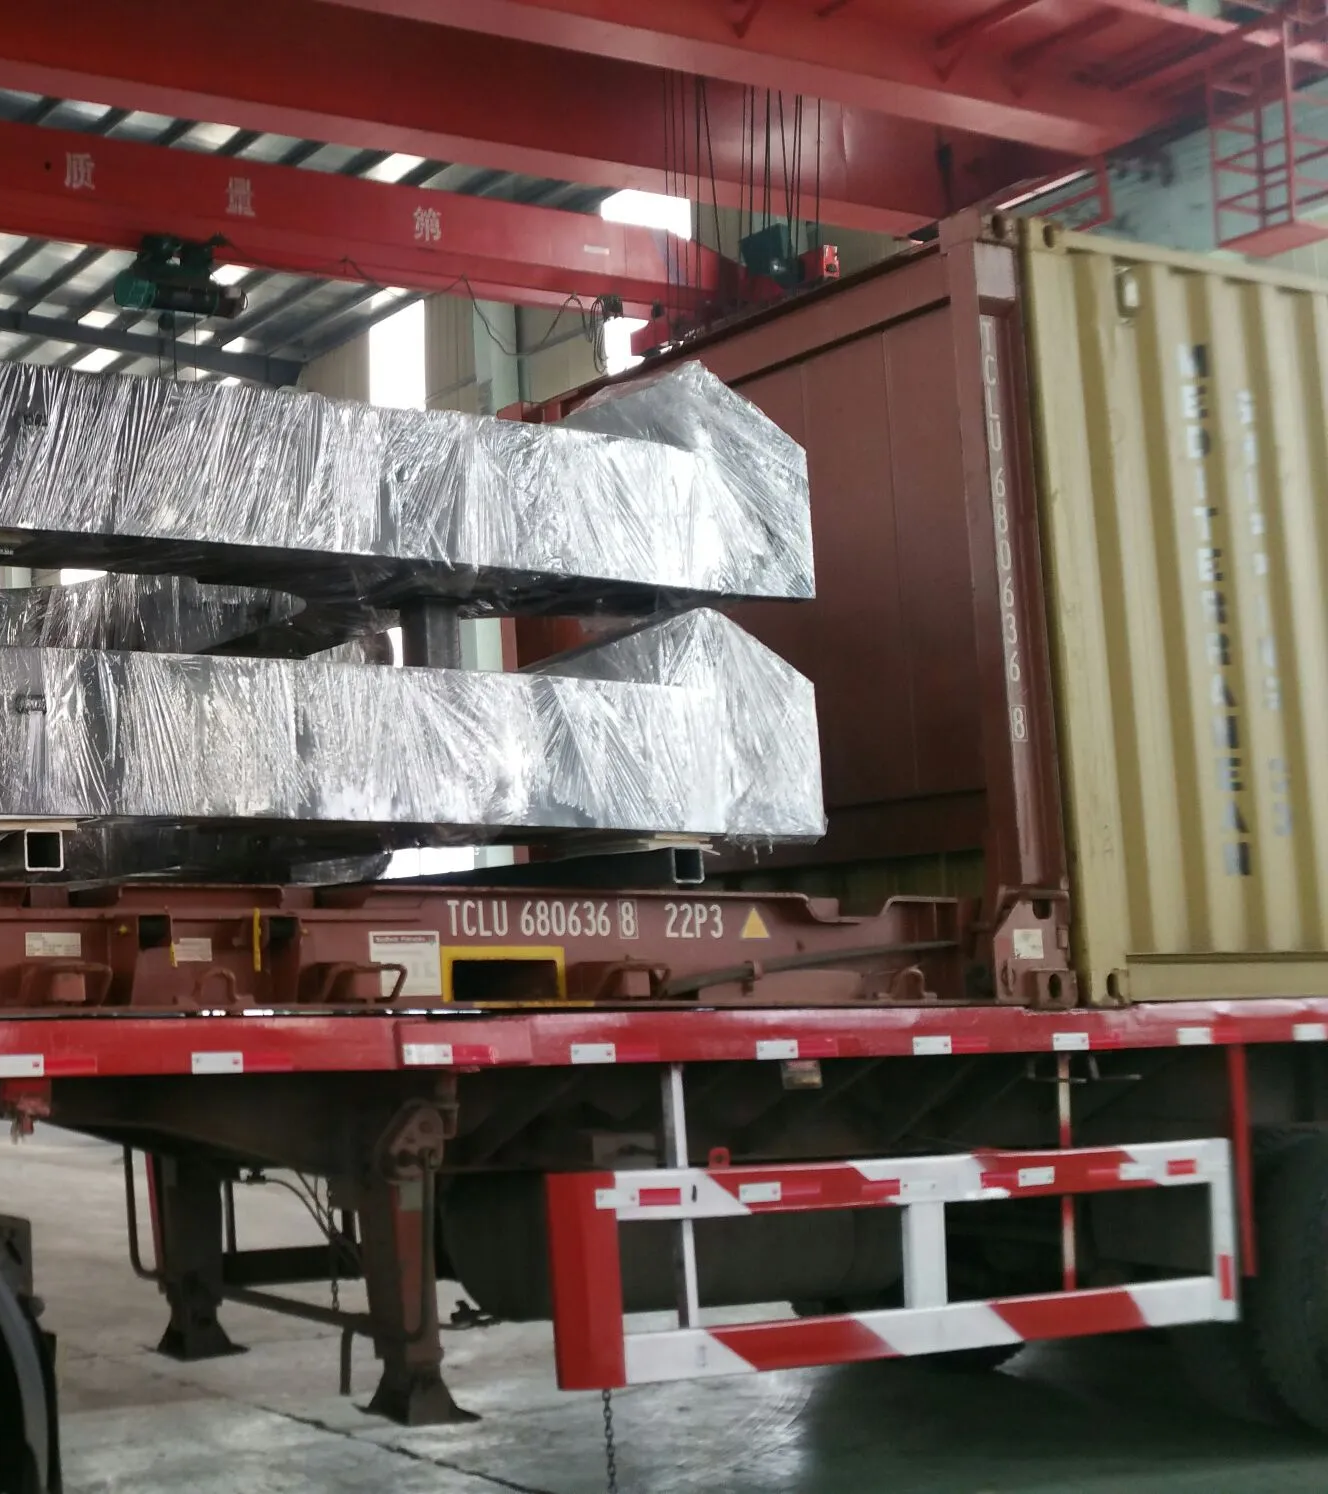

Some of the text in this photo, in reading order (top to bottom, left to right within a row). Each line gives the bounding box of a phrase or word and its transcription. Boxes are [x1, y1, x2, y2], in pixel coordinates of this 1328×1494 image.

[981, 321, 1026, 740] TCLU 680636 8
[1177, 343, 1252, 876] MEDITERRANEAN
[447, 900, 723, 938] TCLU 680636 8 22P3
